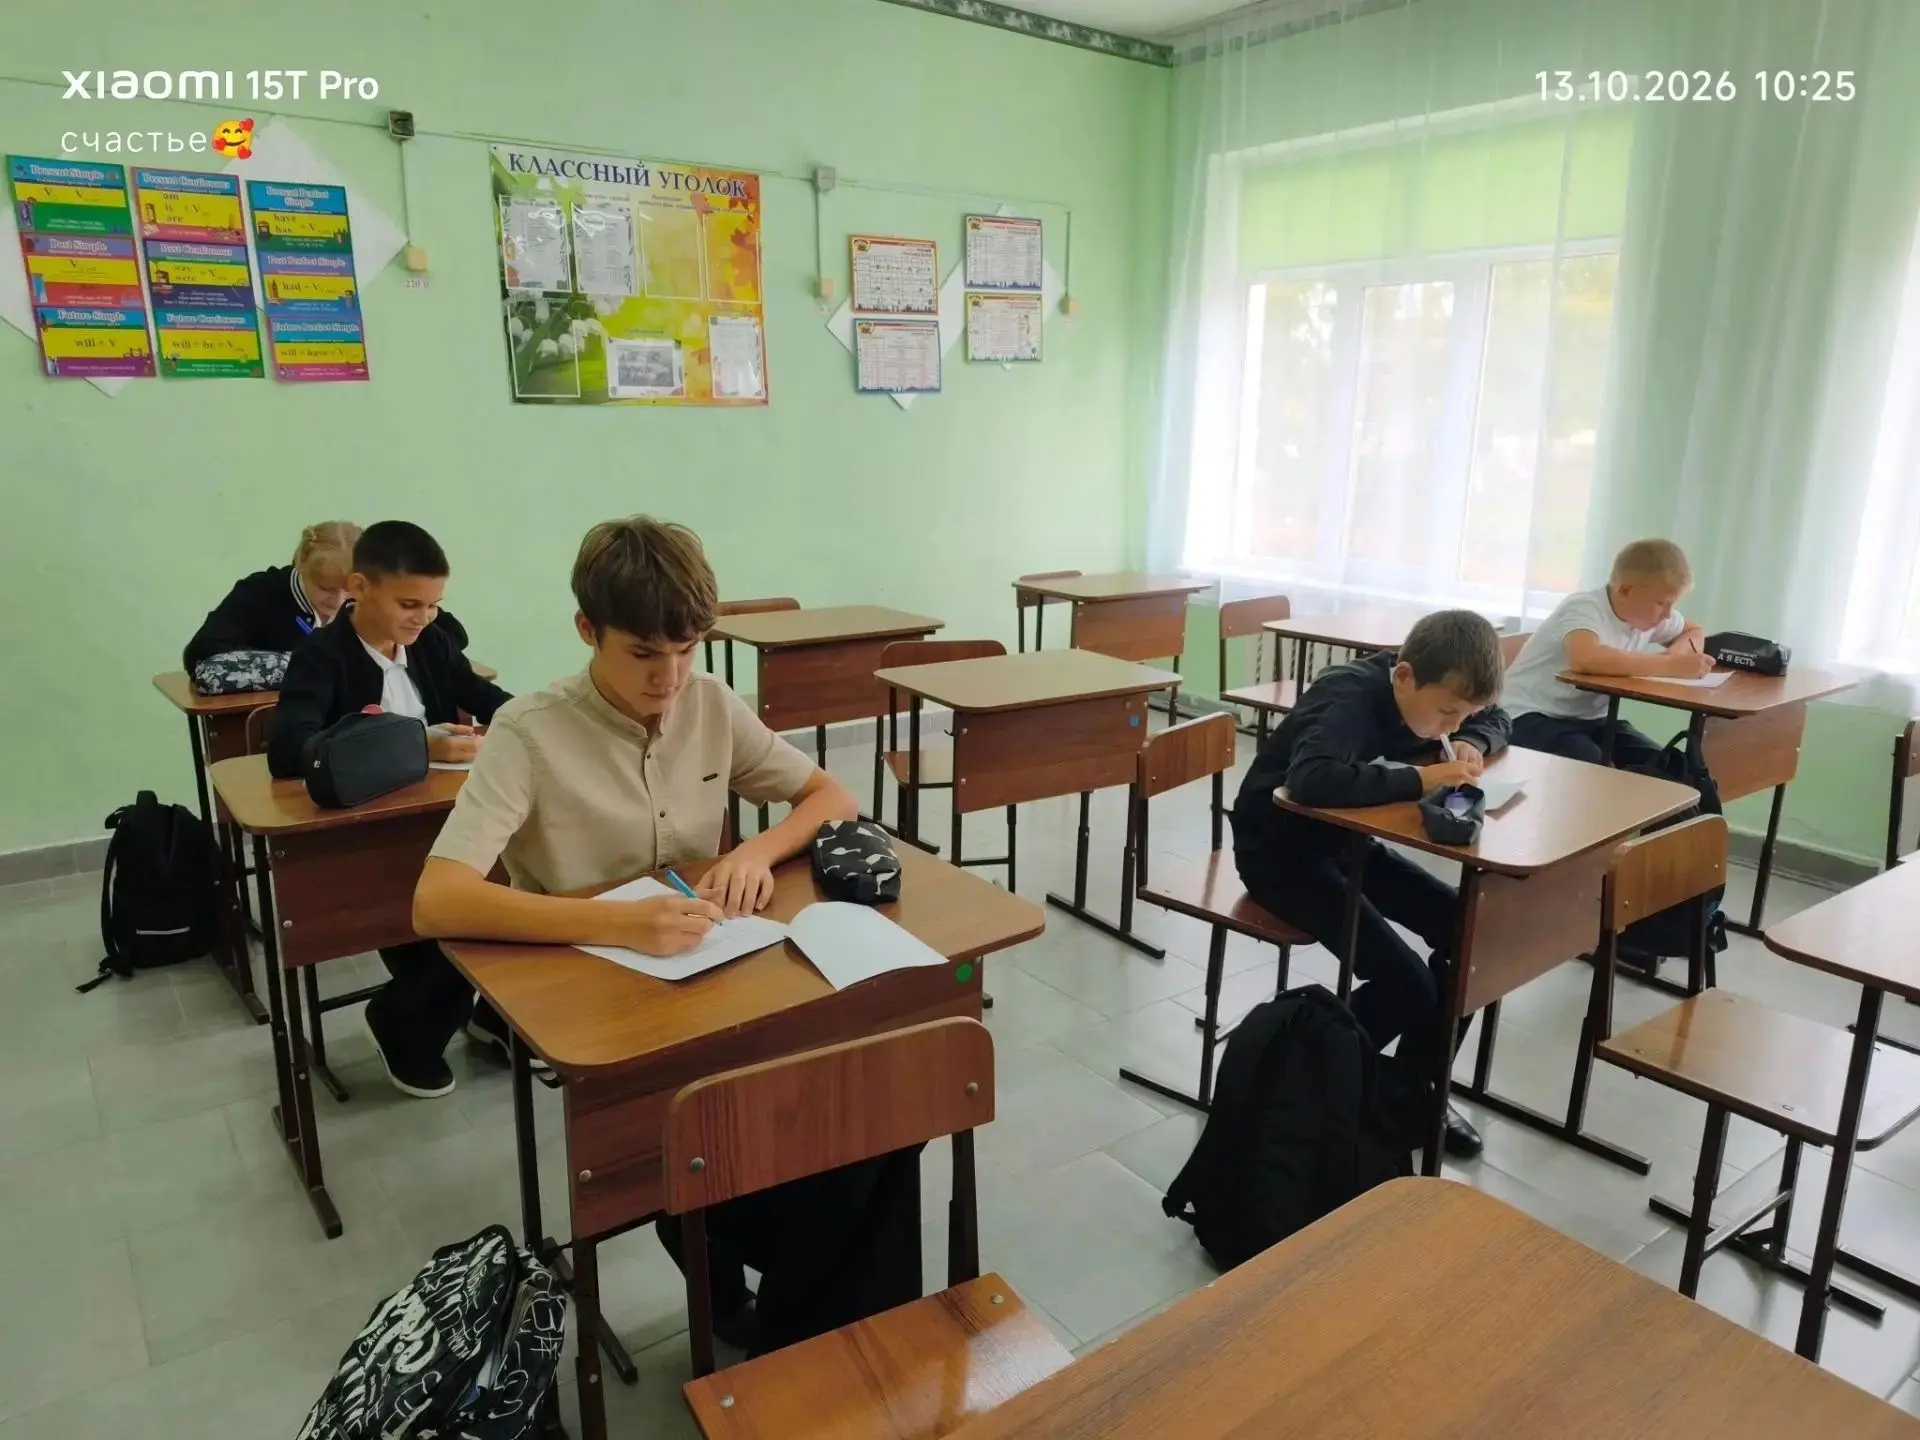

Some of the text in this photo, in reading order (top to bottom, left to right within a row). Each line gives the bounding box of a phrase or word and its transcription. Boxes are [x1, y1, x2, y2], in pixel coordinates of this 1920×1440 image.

[30, 164, 104, 180] Present Simple
[141, 172, 178, 185] Present
[507, 152, 746, 198] КЛАССНЫЙ УГОЛОК
[49, 238, 108, 252] Past Simple
[57, 309, 126, 323] Future Simple
[74, 337, 95, 348] will
[1734, 655, 1756, 668] ЕСТЬ
